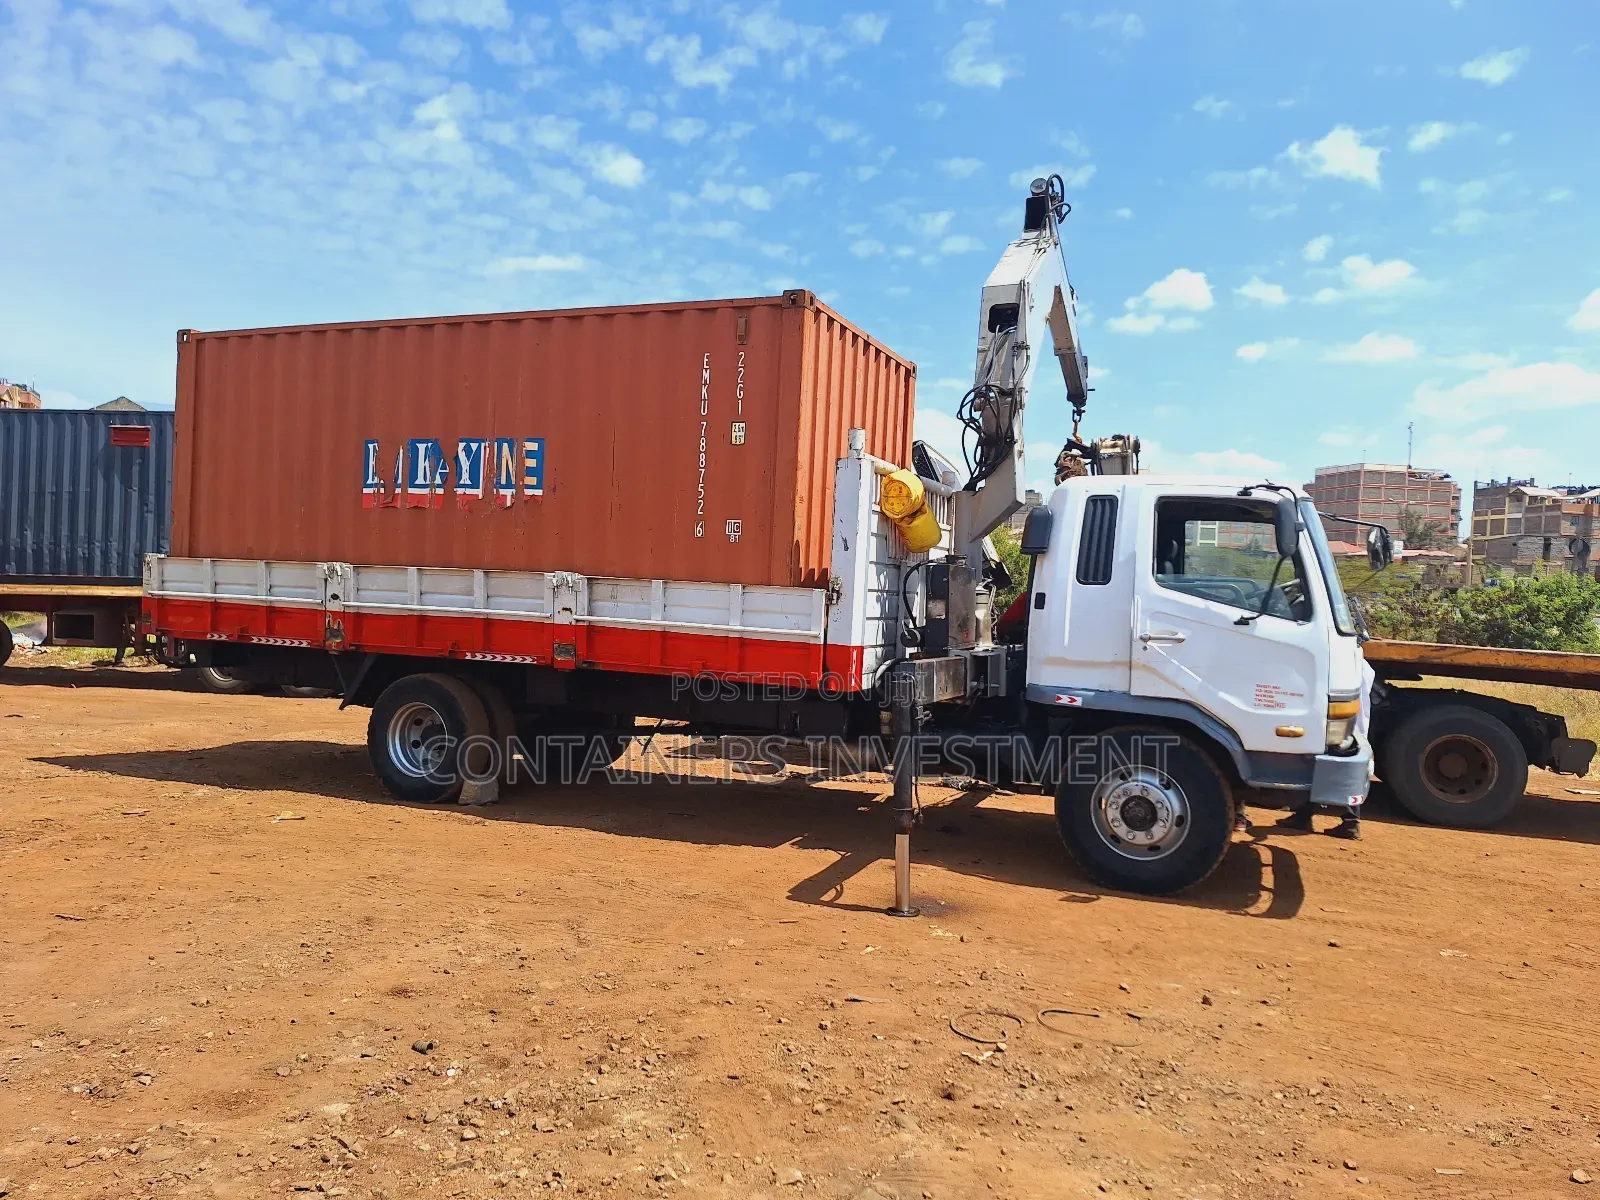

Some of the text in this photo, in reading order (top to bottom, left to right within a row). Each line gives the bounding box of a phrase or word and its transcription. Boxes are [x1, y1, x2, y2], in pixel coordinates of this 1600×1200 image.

[695, 353, 711, 537] EMKU 788752 6
[736, 351, 745, 415] 22G1
